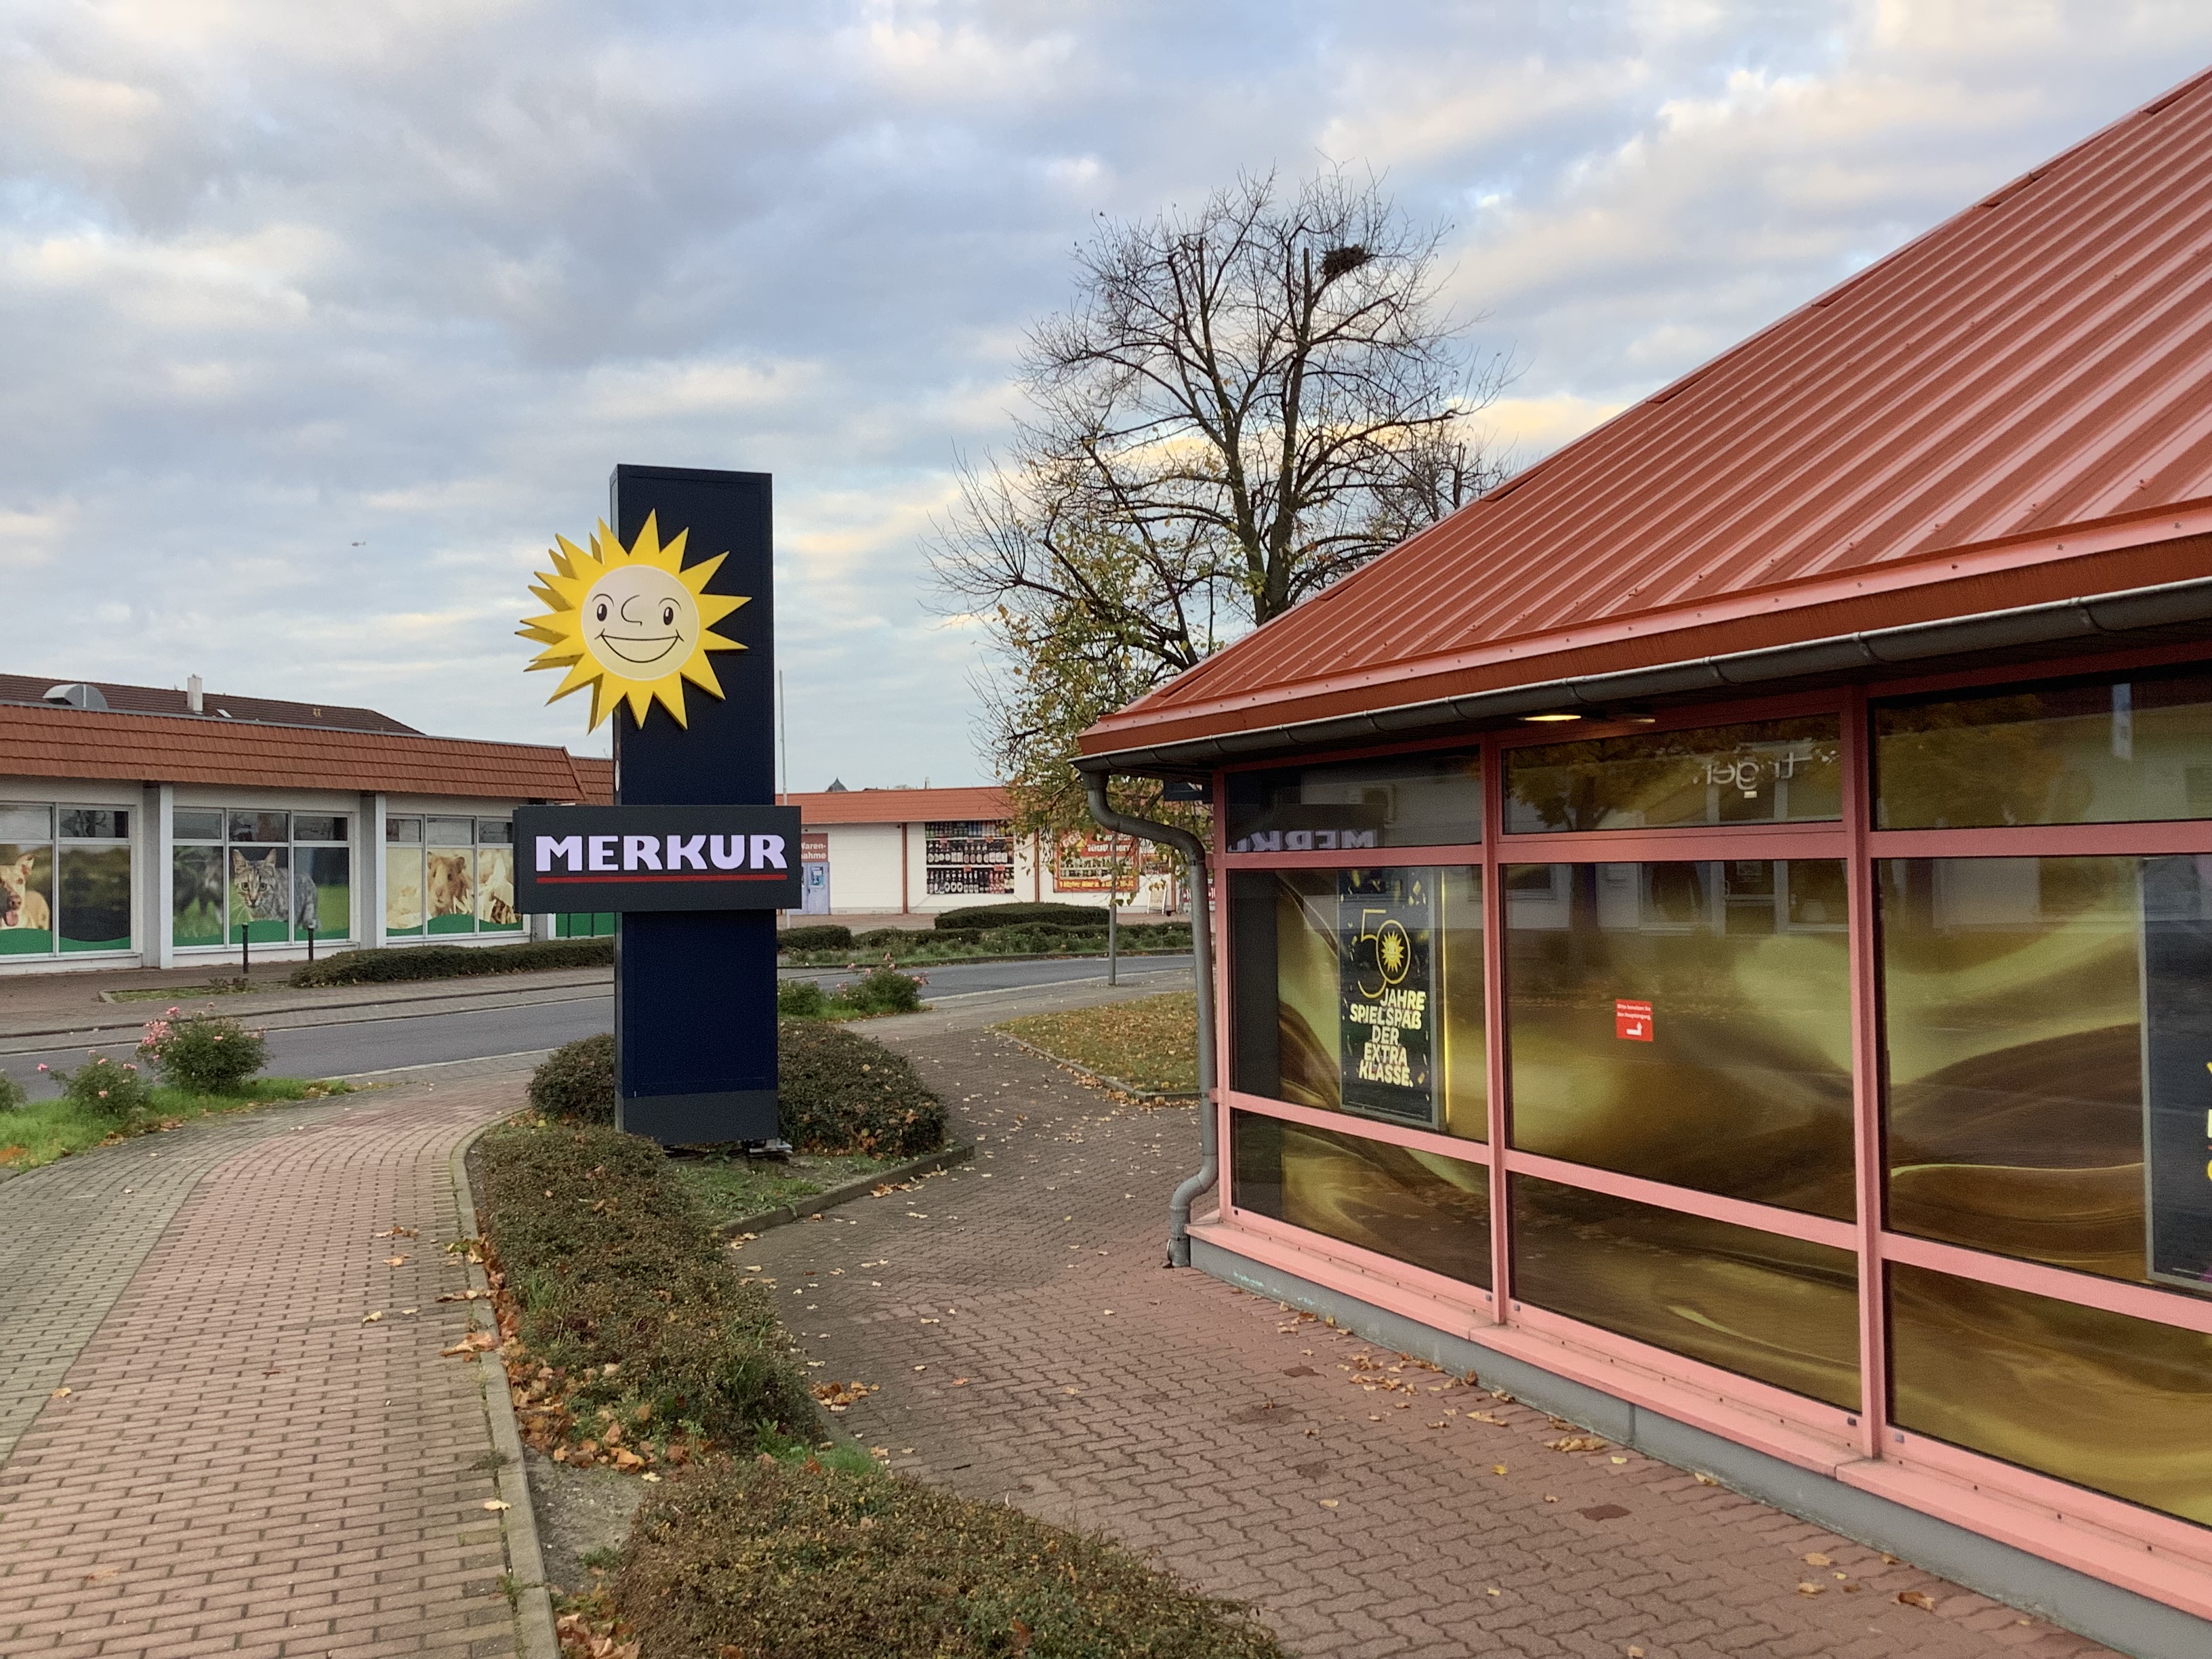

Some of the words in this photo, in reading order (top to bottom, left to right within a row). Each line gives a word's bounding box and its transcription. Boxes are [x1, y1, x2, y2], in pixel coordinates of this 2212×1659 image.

[536, 835, 788, 872] MERKUR
[1357, 909, 1411, 998] 50
[1380, 987, 1426, 1012] JAHRE
[1372, 1025, 1399, 1045] DER
[1364, 1042, 1408, 1067] EXTRA
[1359, 1059, 1414, 1088] KLASSE.
